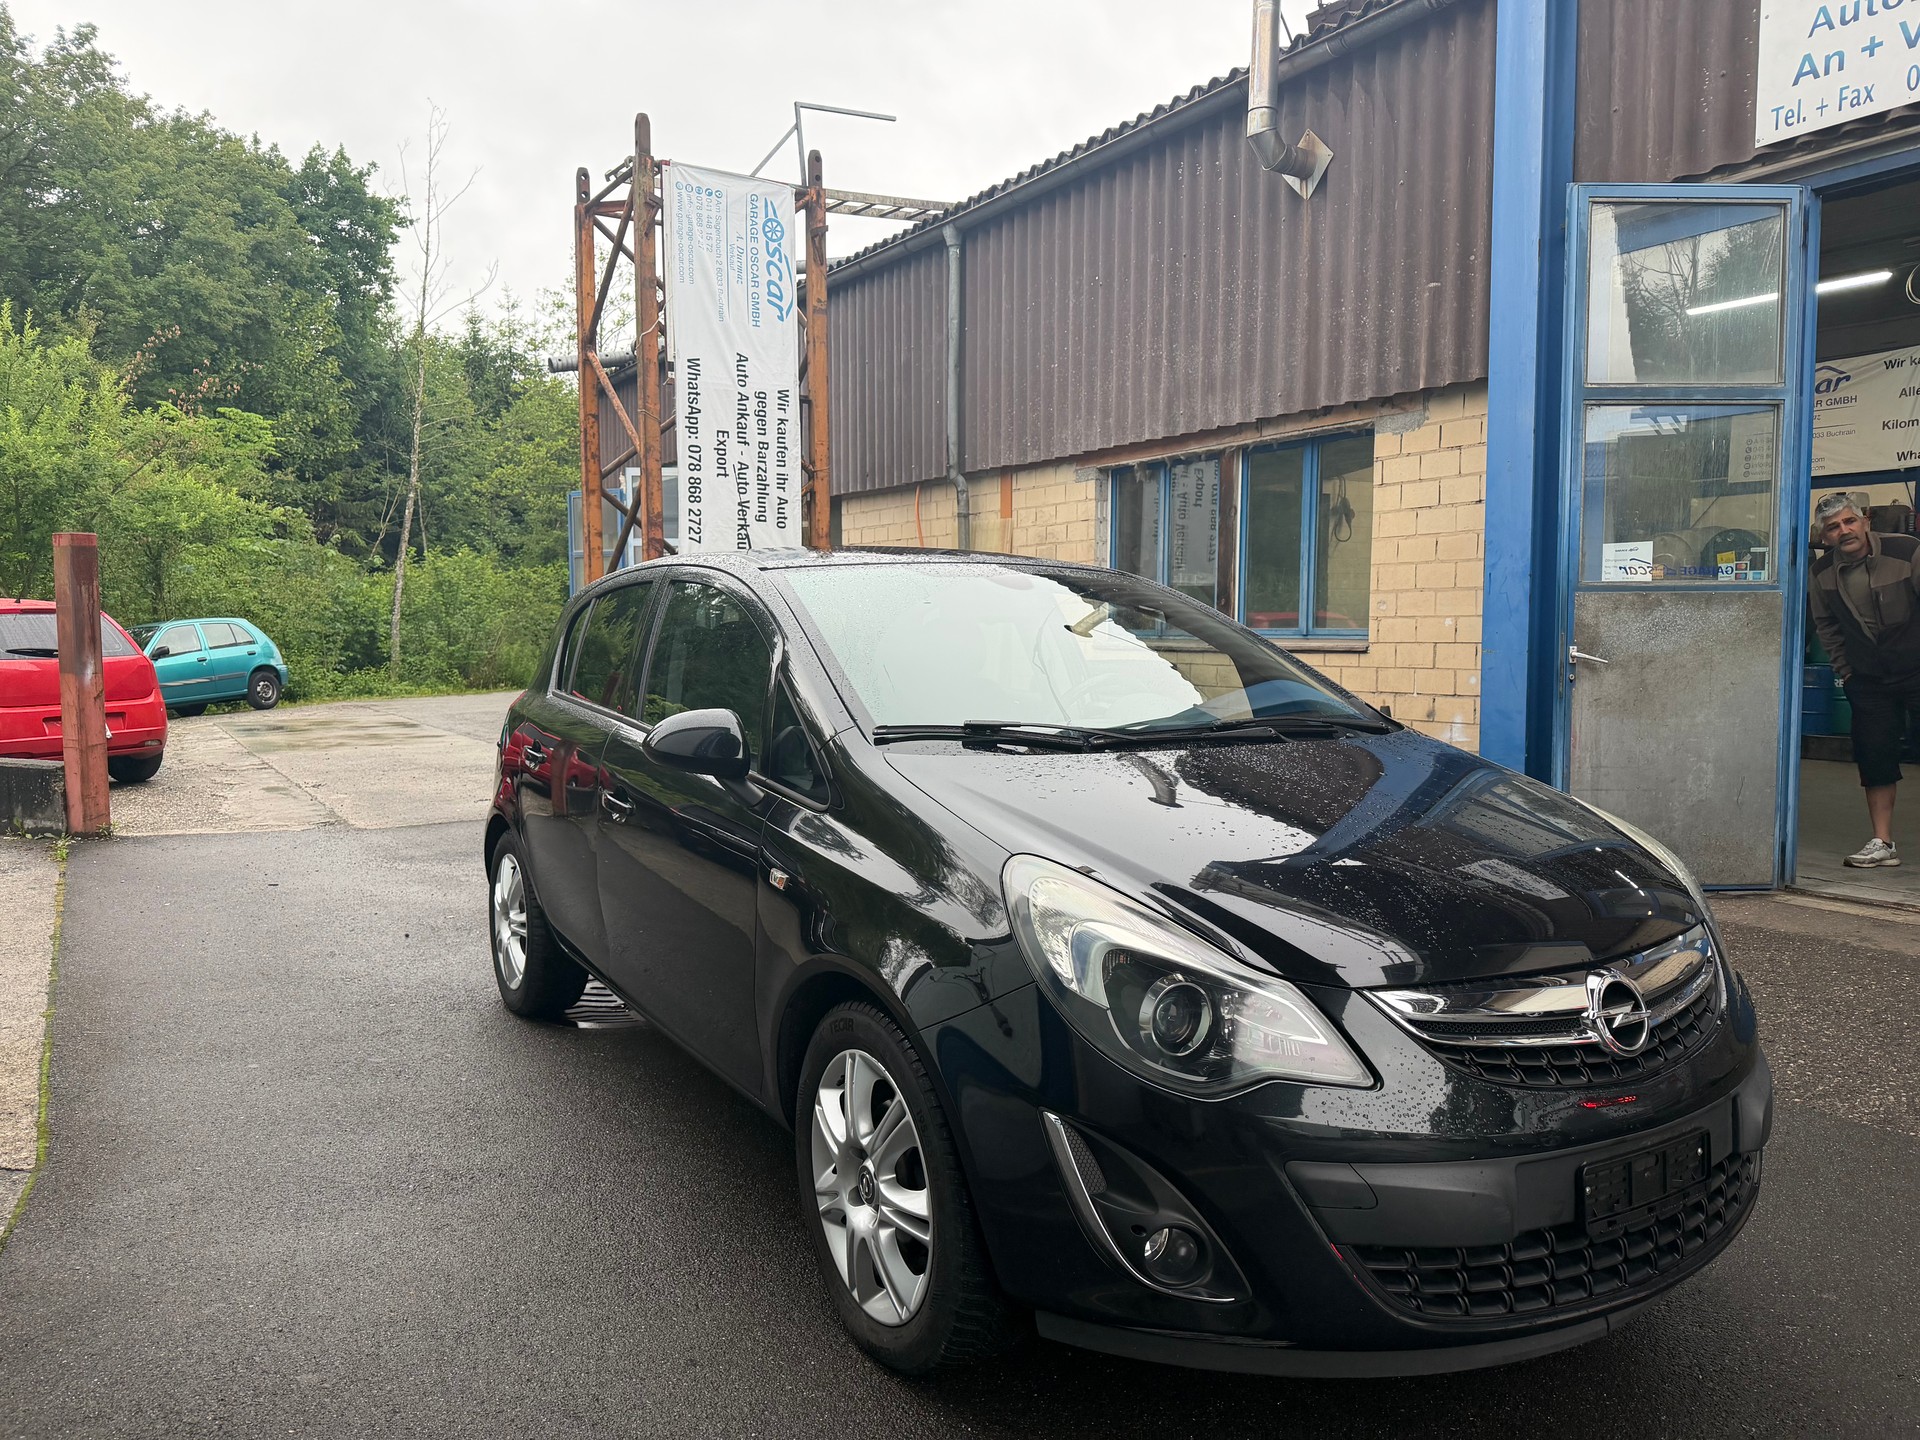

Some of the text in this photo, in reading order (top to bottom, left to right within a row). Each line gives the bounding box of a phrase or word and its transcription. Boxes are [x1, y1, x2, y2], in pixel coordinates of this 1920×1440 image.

[1808, 0, 1919, 38] Aut
[1792, 20, 1920, 87] An + V
[1770, 64, 1920, 130] Tel. + Fax 0
[716, 199, 722, 212] Am
[676, 192, 684, 284] www.garage-oscar.com
[686, 194, 694, 284] infogarage-oscar.com
[706, 244, 713, 252] 72
[750, 194, 760, 328] GARAGE OSCAR GMBH
[736, 246, 744, 284] Durmaz
[762, 217, 785, 322] Oscar
[736, 352, 749, 388] Auto
[1884, 358, 1906, 370] Wir
[737, 391, 750, 446] Ankauf
[1826, 395, 1858, 406] GMBH
[1882, 418, 1920, 430] Kilom
[684, 358, 702, 544] WhatsApp: 078 868 2727
[714, 430, 730, 478] Export
[754, 391, 770, 522] gegen Barzahlung
[776, 389, 790, 528] Wir kaufen ihr Auto
[1896, 450, 1920, 462] Wha
[738, 461, 750, 494] Auto
[736, 500, 750, 550] Verkau
